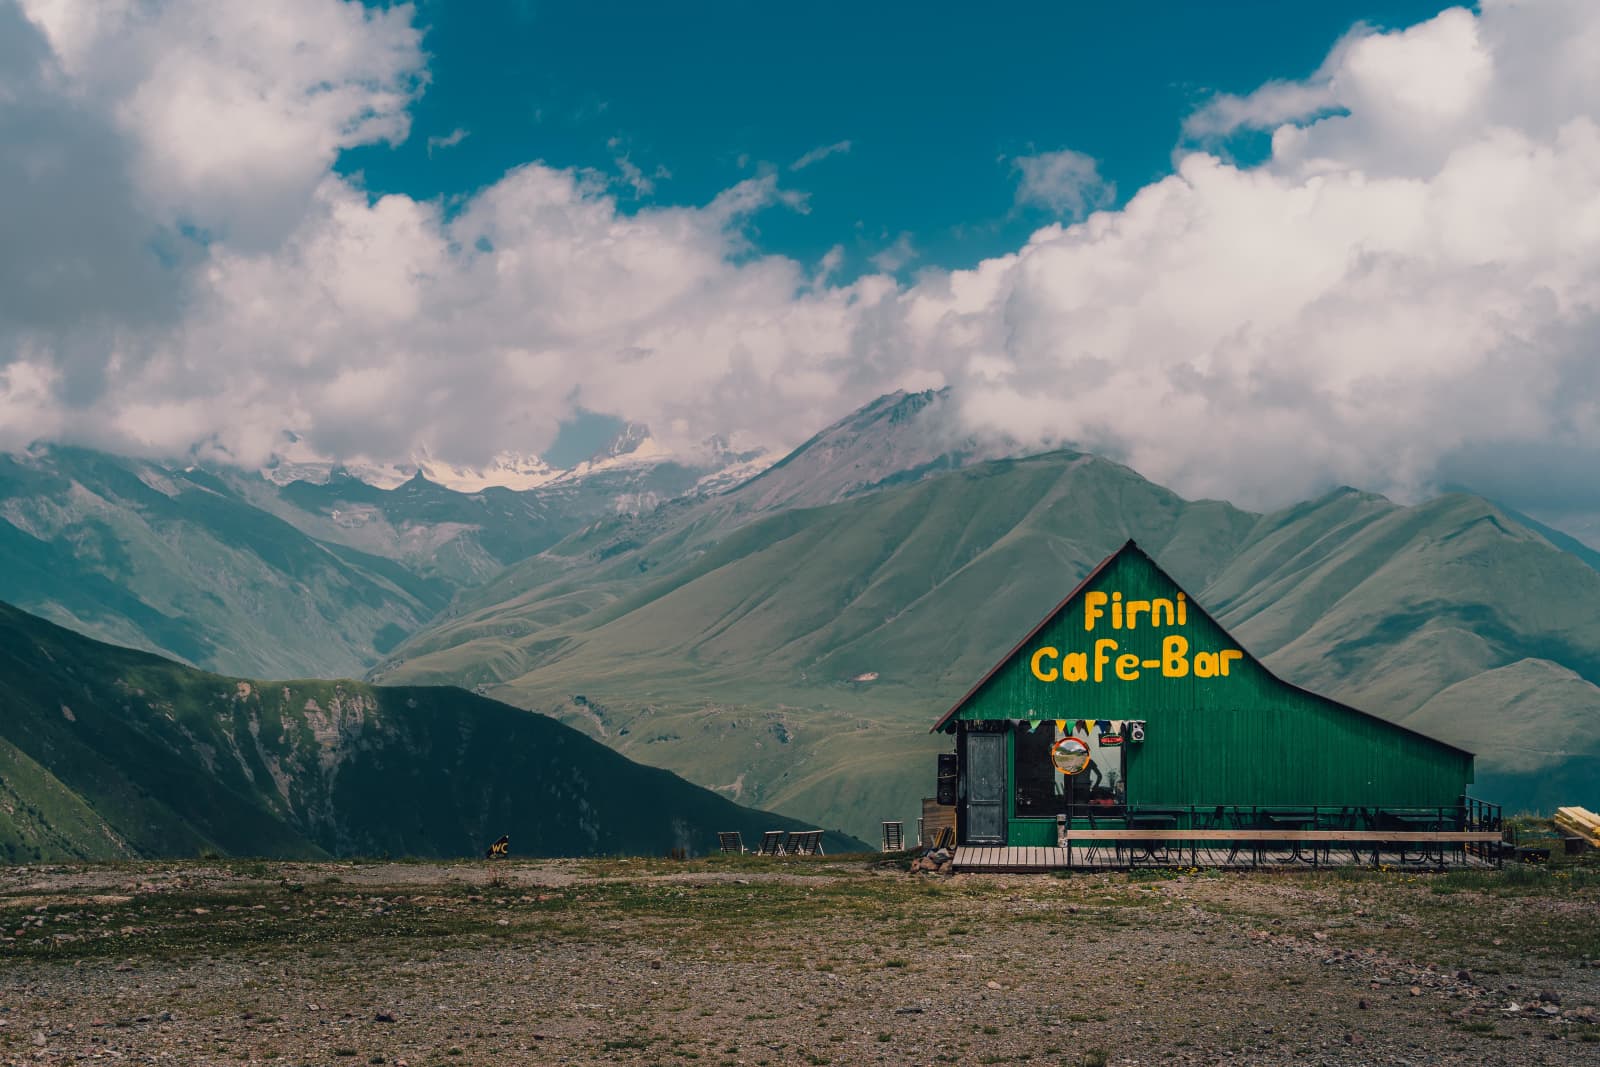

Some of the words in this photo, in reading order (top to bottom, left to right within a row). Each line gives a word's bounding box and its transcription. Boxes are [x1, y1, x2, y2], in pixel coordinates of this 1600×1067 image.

[1084, 591, 1187, 632] Firni
[1030, 634, 1243, 683] Cafe-Bar
[492, 842, 508, 854] WC
